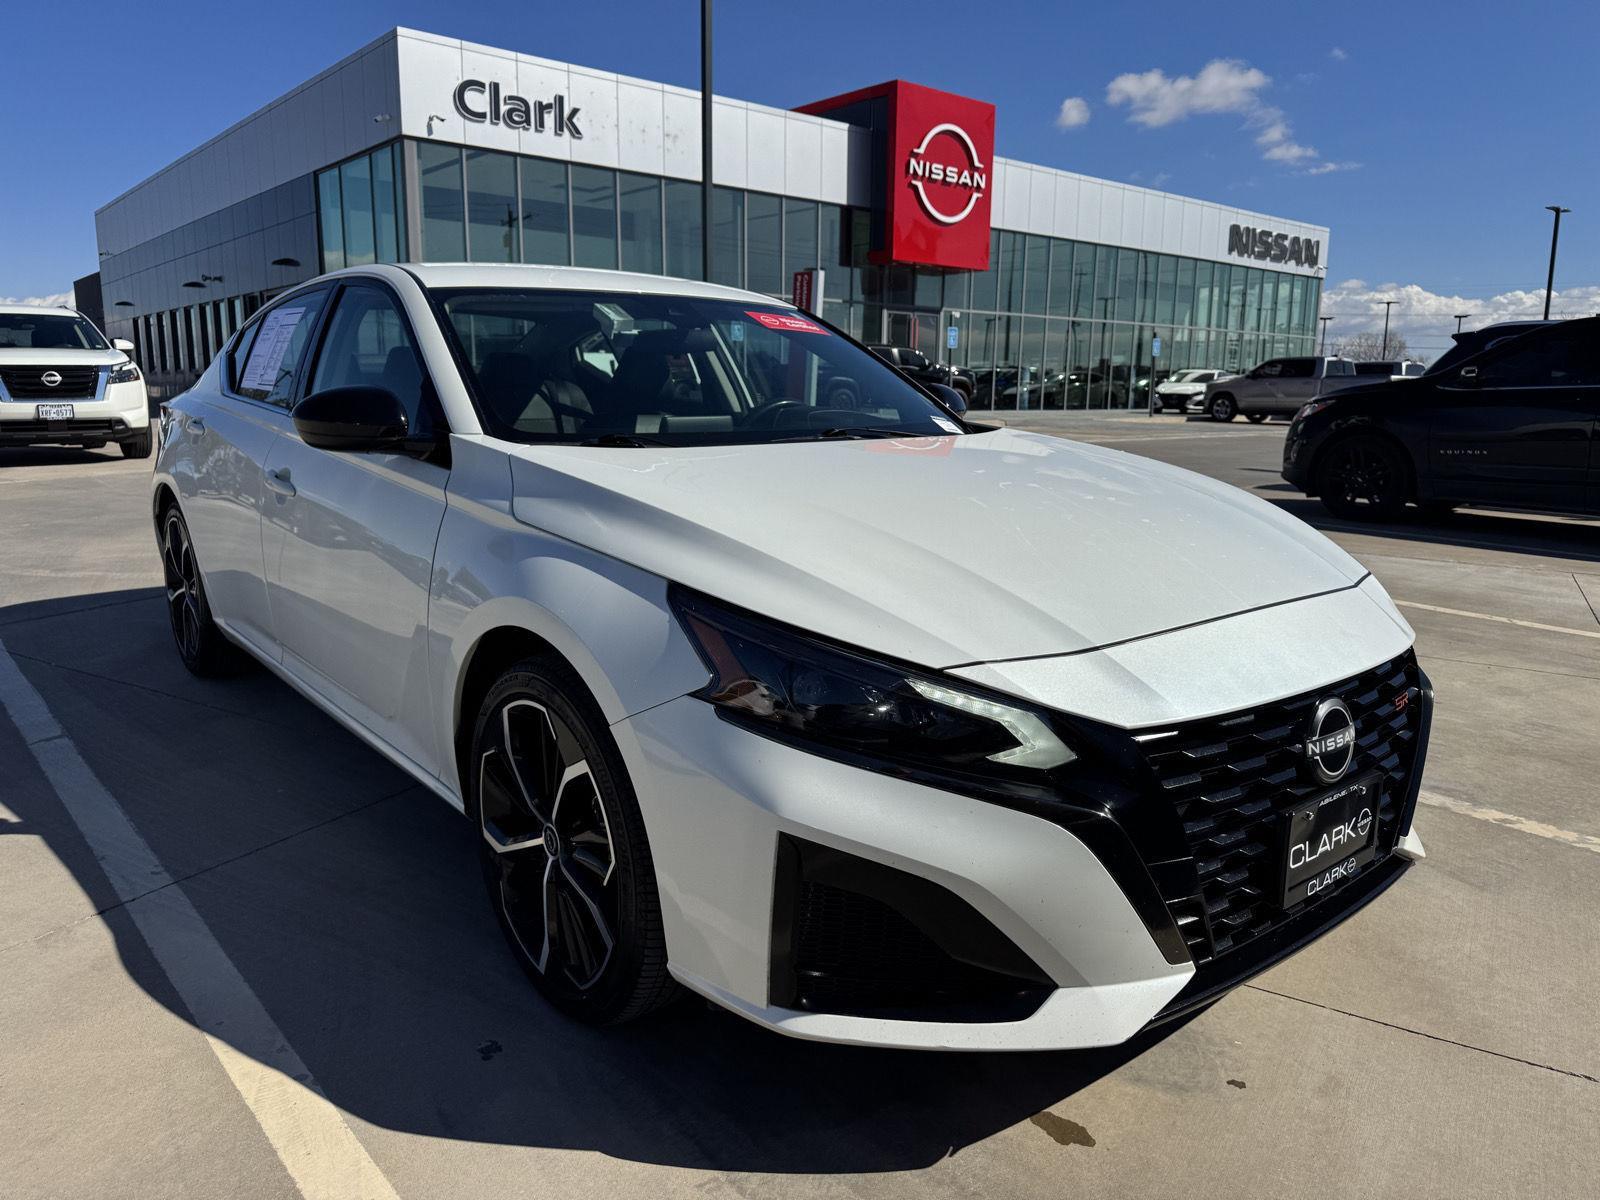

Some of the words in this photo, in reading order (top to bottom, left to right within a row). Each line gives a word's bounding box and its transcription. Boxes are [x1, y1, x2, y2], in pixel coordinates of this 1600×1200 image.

[453, 79, 583, 140] Clark
[908, 157, 986, 189] NISSAN
[1228, 224, 1320, 269] NISSAN
[1395, 691, 1409, 711] SR
[1308, 728, 1355, 755] NISSAN
[1350, 784, 1359, 792] TX
[1289, 816, 1357, 869] CLARK
[1307, 861, 1347, 896] CLARK
